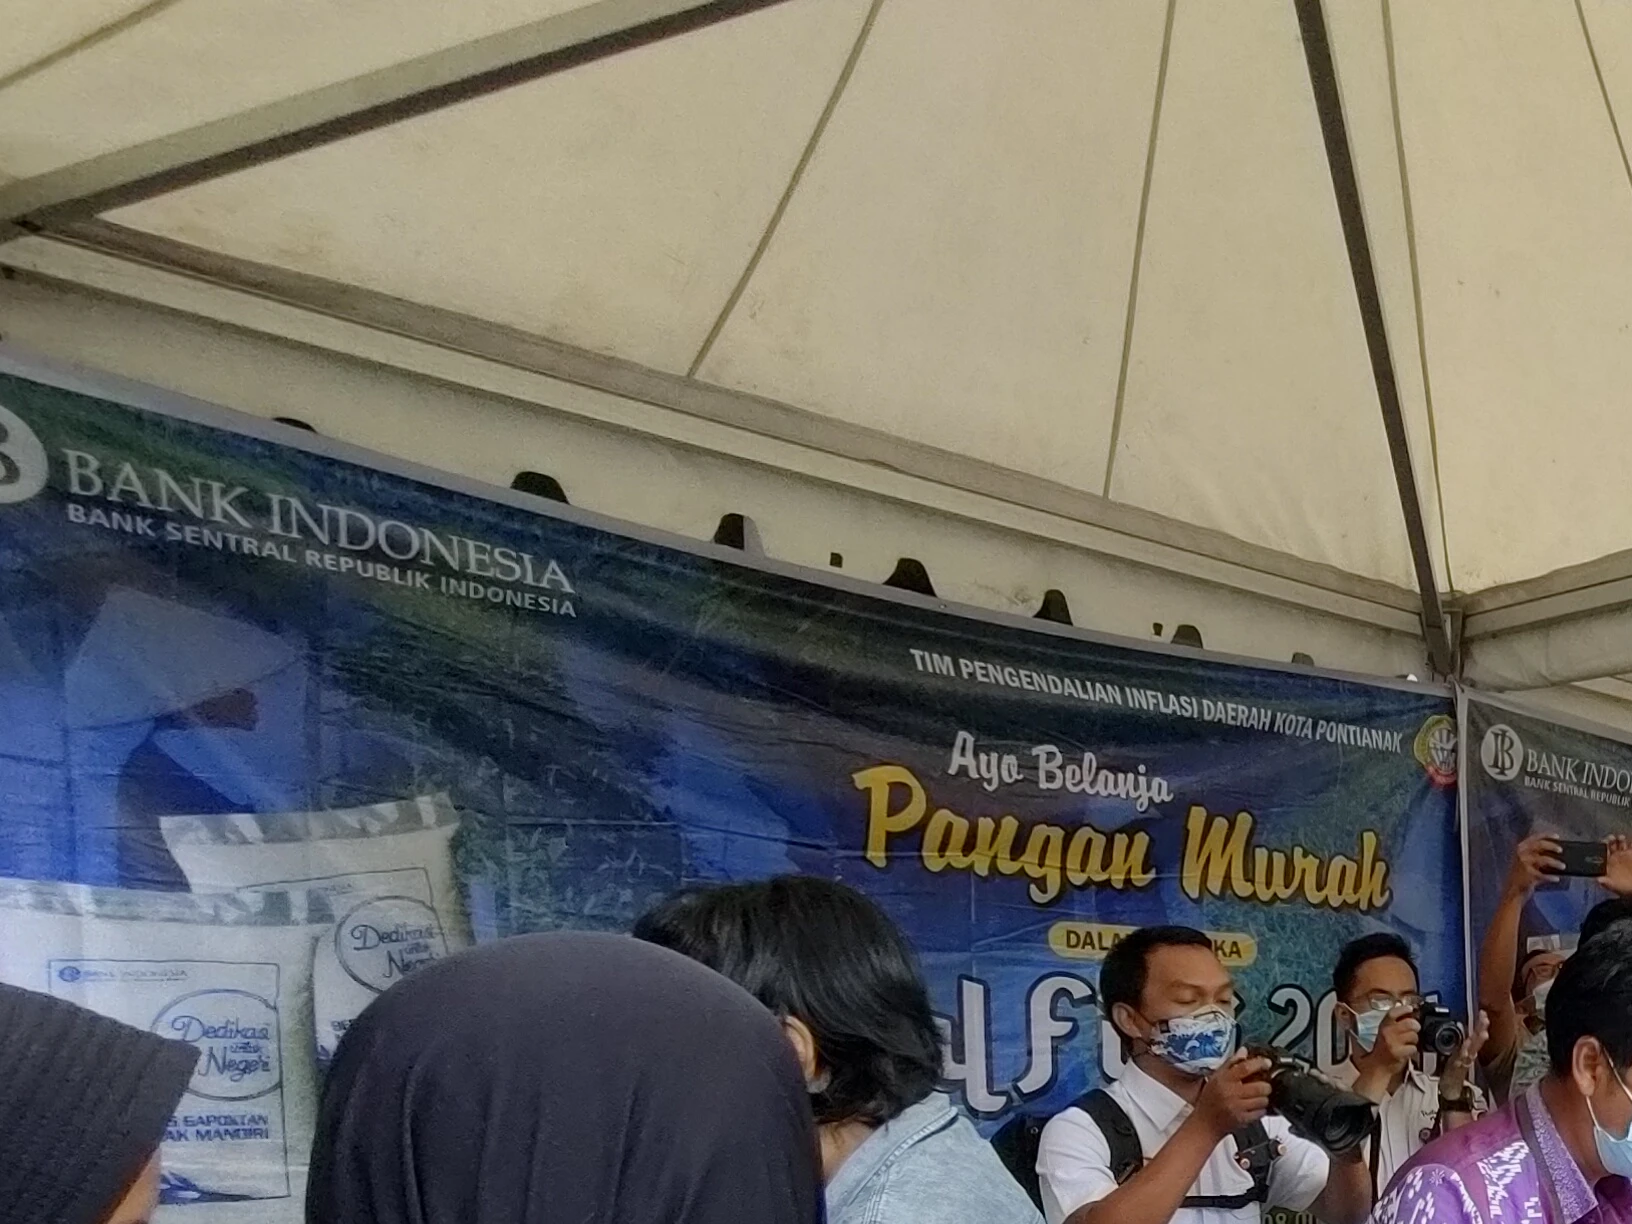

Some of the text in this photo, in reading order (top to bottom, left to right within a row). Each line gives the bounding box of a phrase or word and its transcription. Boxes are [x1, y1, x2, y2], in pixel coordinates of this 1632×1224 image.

[61, 448, 576, 594] BANK INDONESIA
[67, 503, 577, 618] BANK SENTRAL REPUBLIK INDONESIA
[909, 648, 1402, 753] TIM PENGENDALIAN INFLASI DAERAH KOTA PONTIANAK
[948, 730, 1174, 812] Ayo Belanja
[1524, 776, 1550, 790] BANK
[1553, 781, 1589, 799] SENTRAL
[1591, 790, 1630, 808] REPUBLIK
[1527, 749, 1580, 782] BANK
[852, 764, 1391, 911] Pangan Murah
[1066, 930, 1122, 950] DALA
